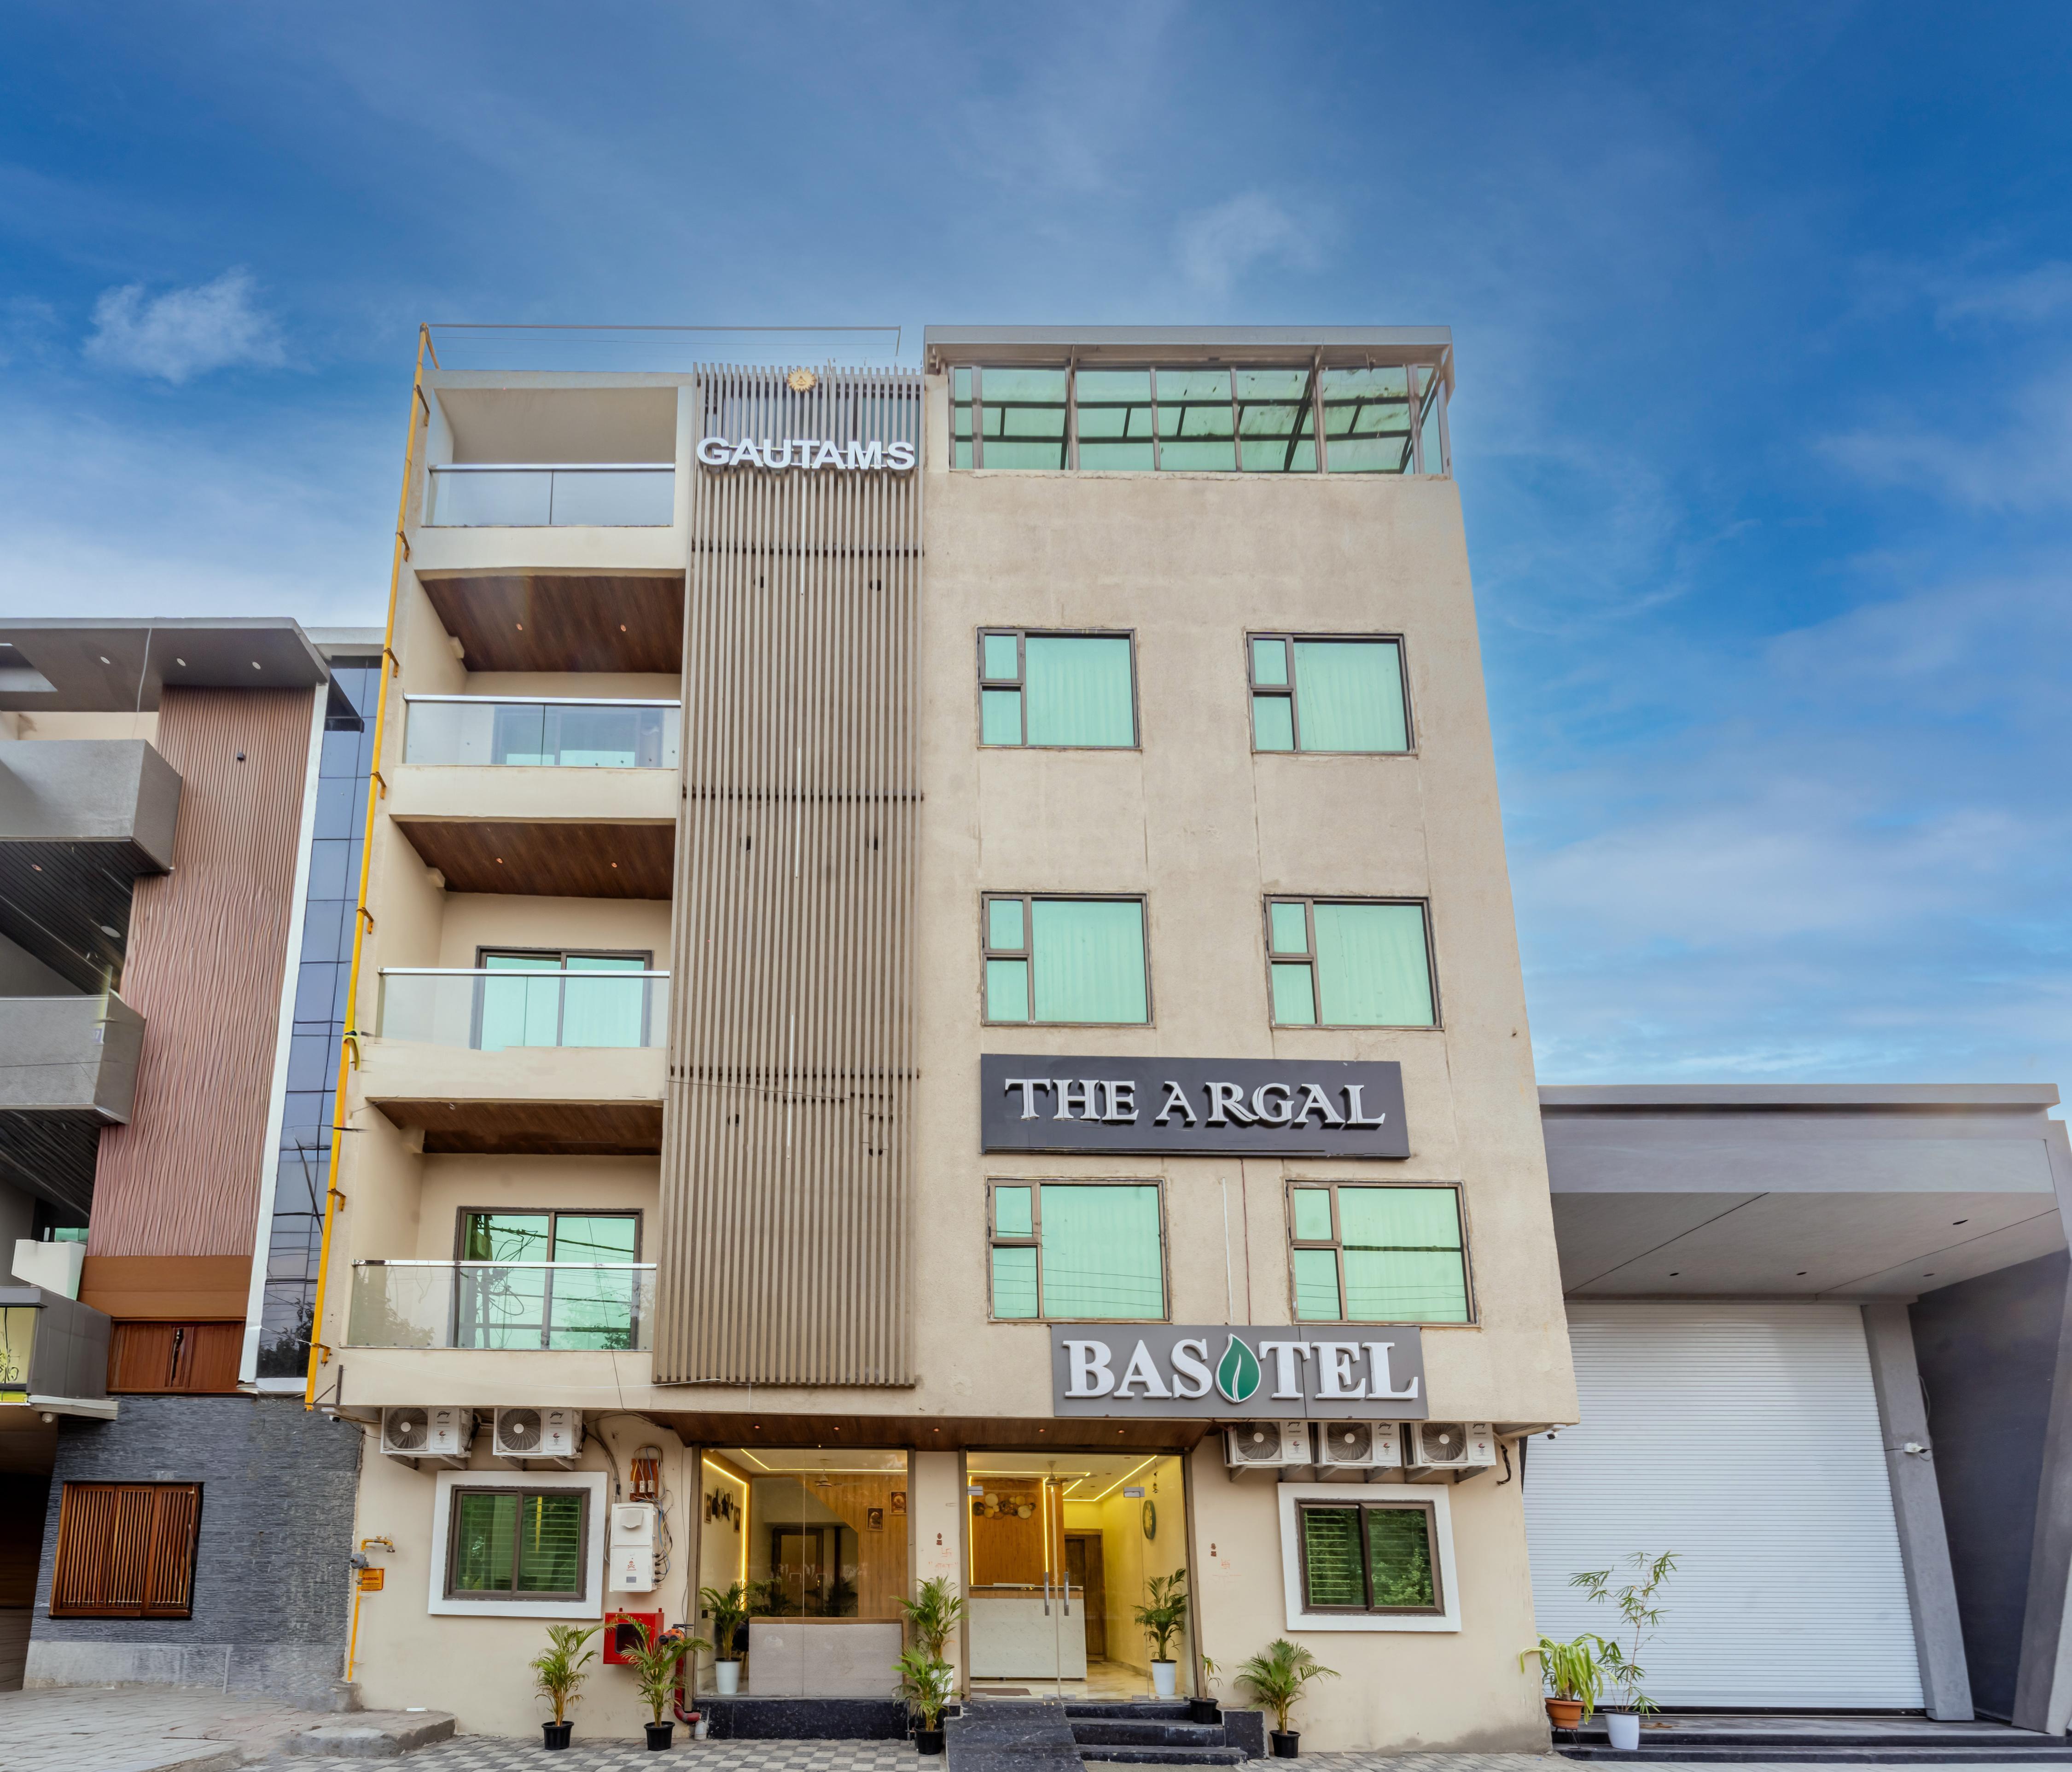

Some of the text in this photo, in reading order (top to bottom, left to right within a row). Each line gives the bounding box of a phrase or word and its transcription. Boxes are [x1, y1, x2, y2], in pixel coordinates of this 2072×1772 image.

[697, 437, 915, 471] GAUTAMS
[1005, 1078, 1386, 1128] THE ARGAL
